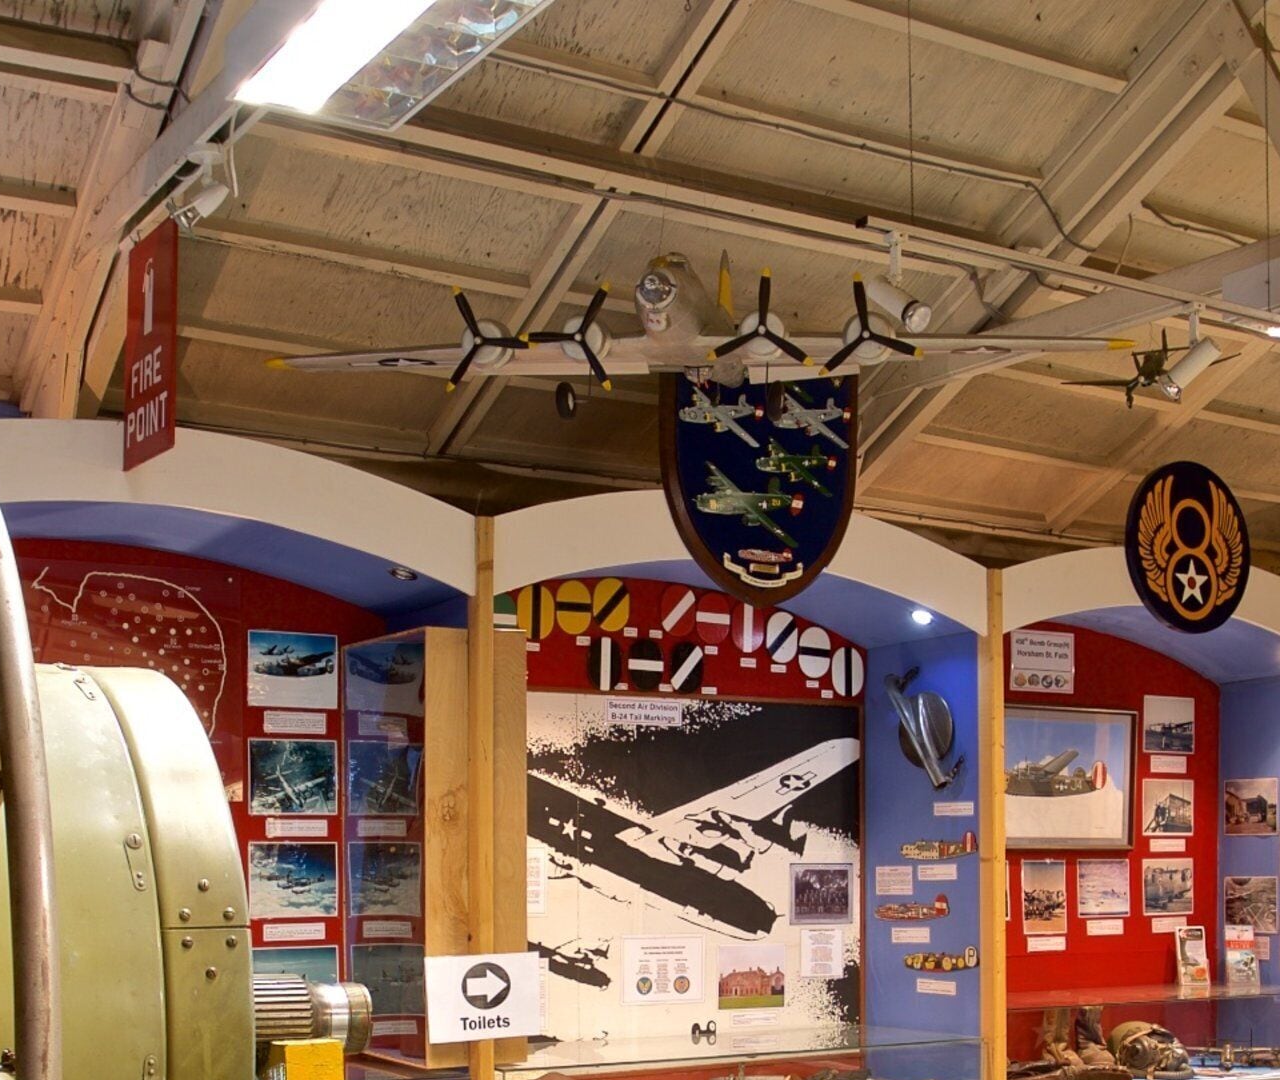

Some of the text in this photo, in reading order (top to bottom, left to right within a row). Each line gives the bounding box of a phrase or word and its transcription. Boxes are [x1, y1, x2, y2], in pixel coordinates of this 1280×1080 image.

[131, 345, 162, 399] FIRE
[126, 390, 168, 449] POINT
[608, 701, 636, 710] Second
[650, 703, 678, 712] Division
[611, 712, 628, 720] B-24
[644, 714, 676, 724] Markings
[460, 1015, 510, 1031] Toilets
